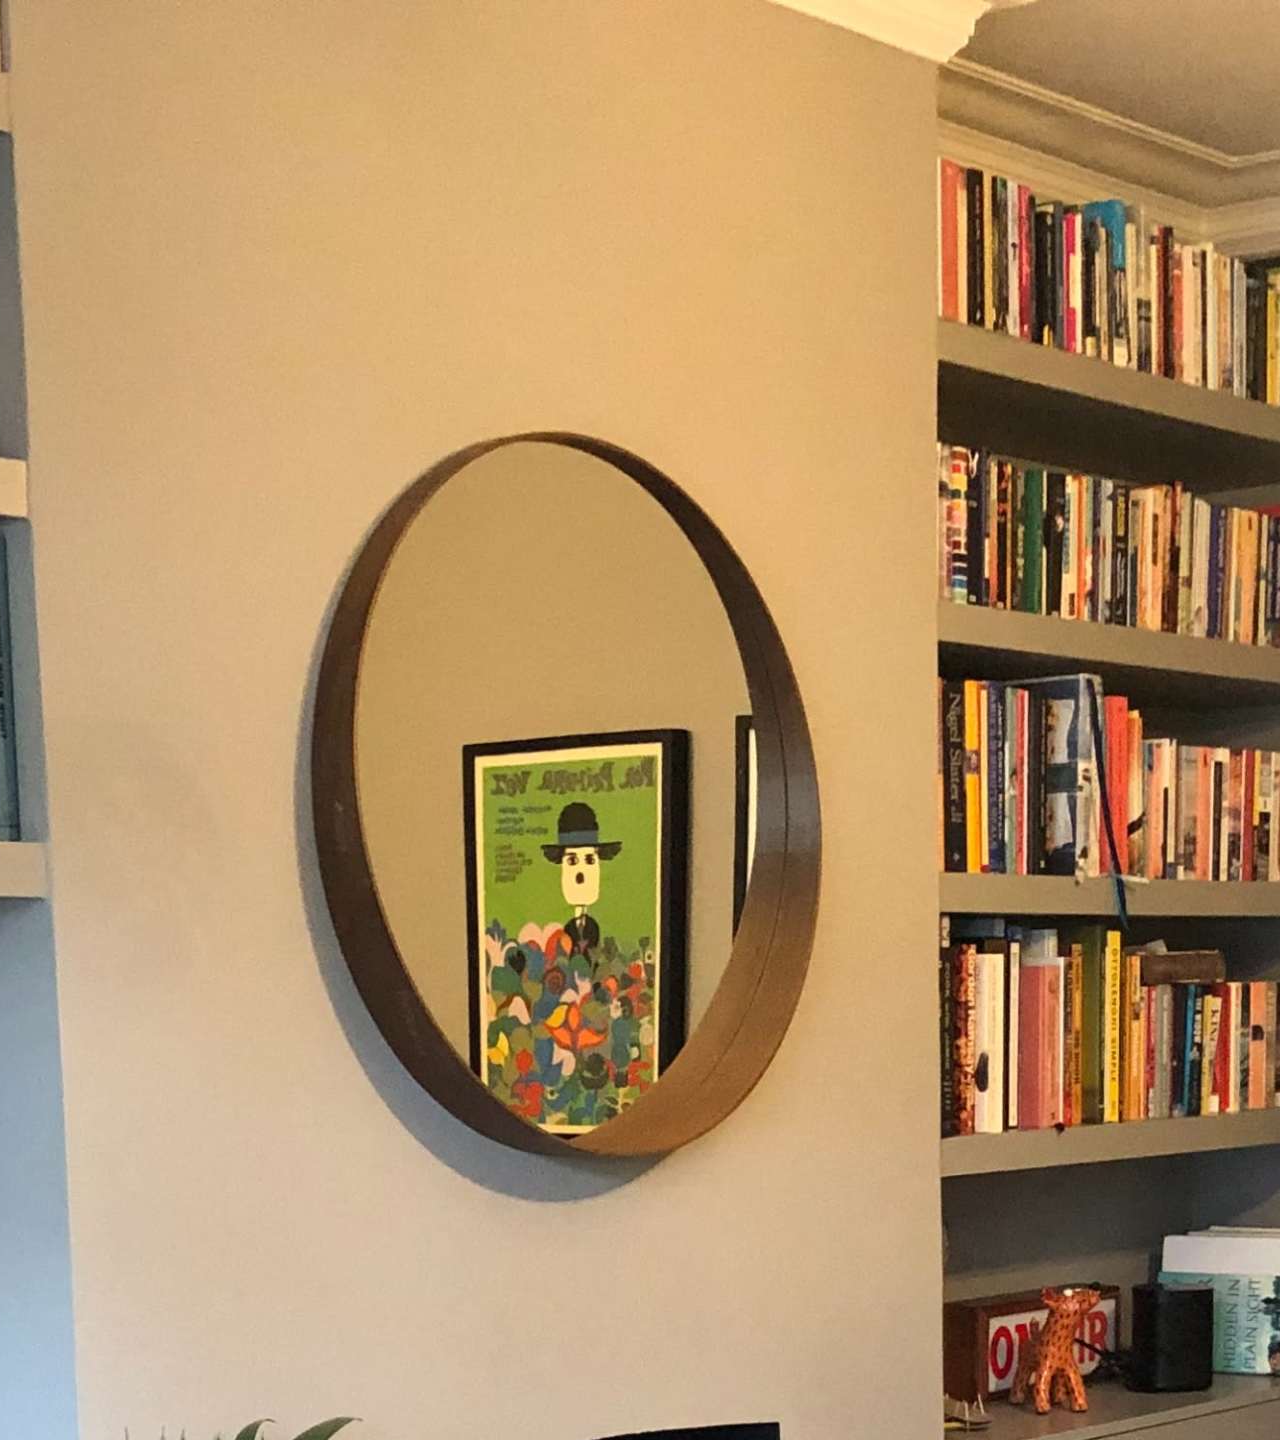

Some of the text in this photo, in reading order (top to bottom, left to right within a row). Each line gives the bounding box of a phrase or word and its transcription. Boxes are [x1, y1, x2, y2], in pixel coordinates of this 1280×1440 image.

[946, 690, 961, 743] Nigel
[949, 746, 963, 802] Slater
[1109, 946, 1119, 1084] OTTOLENGHI SIMPLE
[1222, 1278, 1243, 1370] HIDDEN IN
[1243, 1277, 1263, 1371] PLAIN SIGHT
